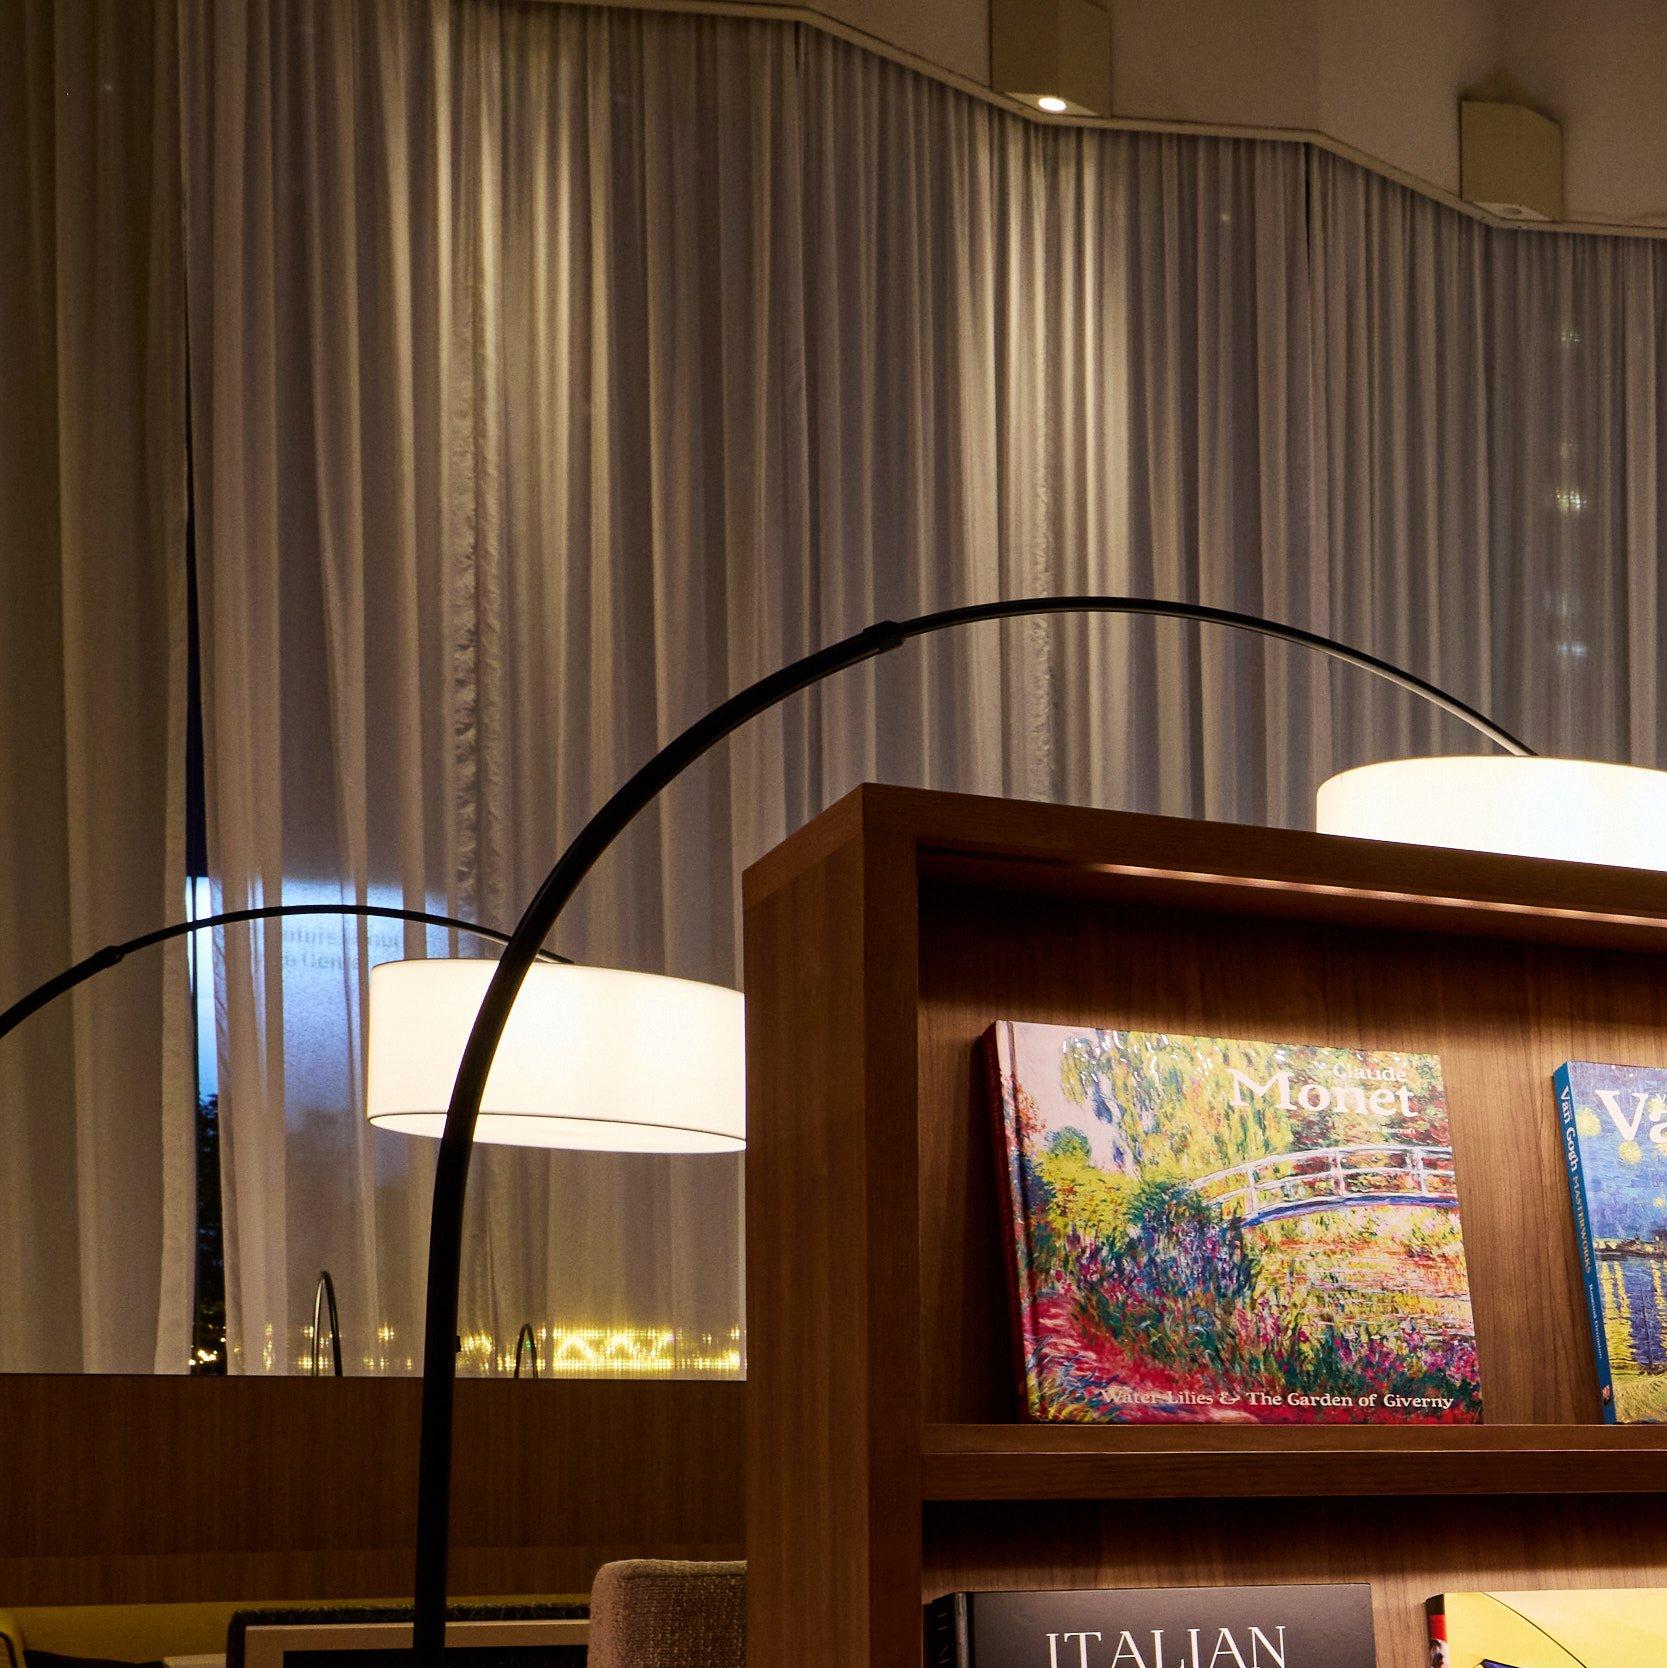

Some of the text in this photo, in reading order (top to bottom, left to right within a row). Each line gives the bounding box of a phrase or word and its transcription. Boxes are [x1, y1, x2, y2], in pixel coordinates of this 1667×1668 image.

[1333, 1063, 1407, 1082] Claude
[1226, 1068, 1418, 1118] Monet
[1560, 1085, 1578, 1173] Van Gogh
[1219, 1391, 1453, 1410] & The Garden of Giverny
